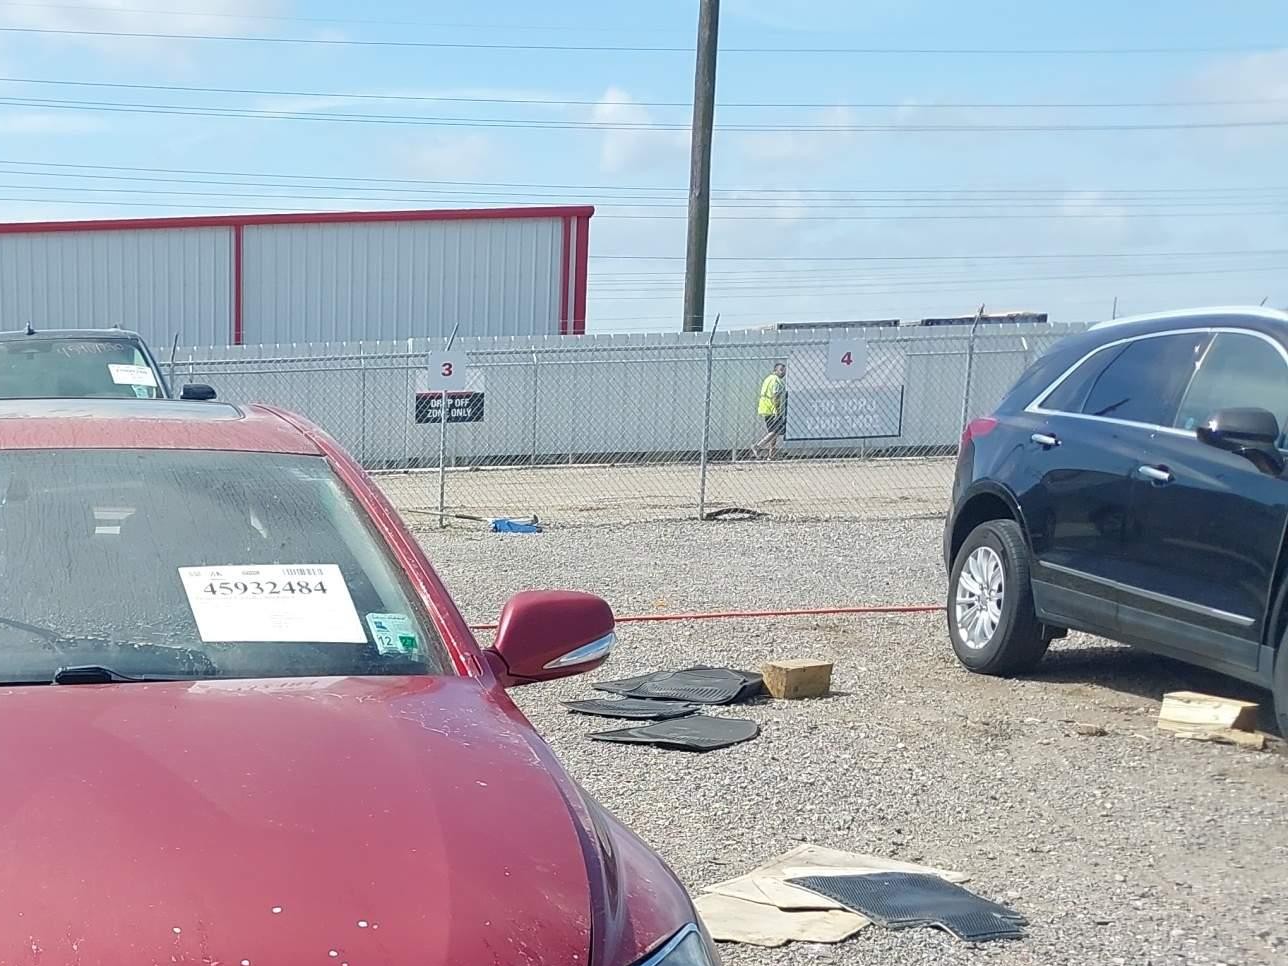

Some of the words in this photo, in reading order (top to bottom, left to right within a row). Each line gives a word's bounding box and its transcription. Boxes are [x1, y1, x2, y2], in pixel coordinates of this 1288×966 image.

[841, 352, 852, 365] 4
[442, 363, 452, 376] 3
[455, 398, 469, 407] OFF
[451, 408, 472, 416] ONLY
[203, 580, 328, 596] 45932484
[377, 635, 393, 647] 12
